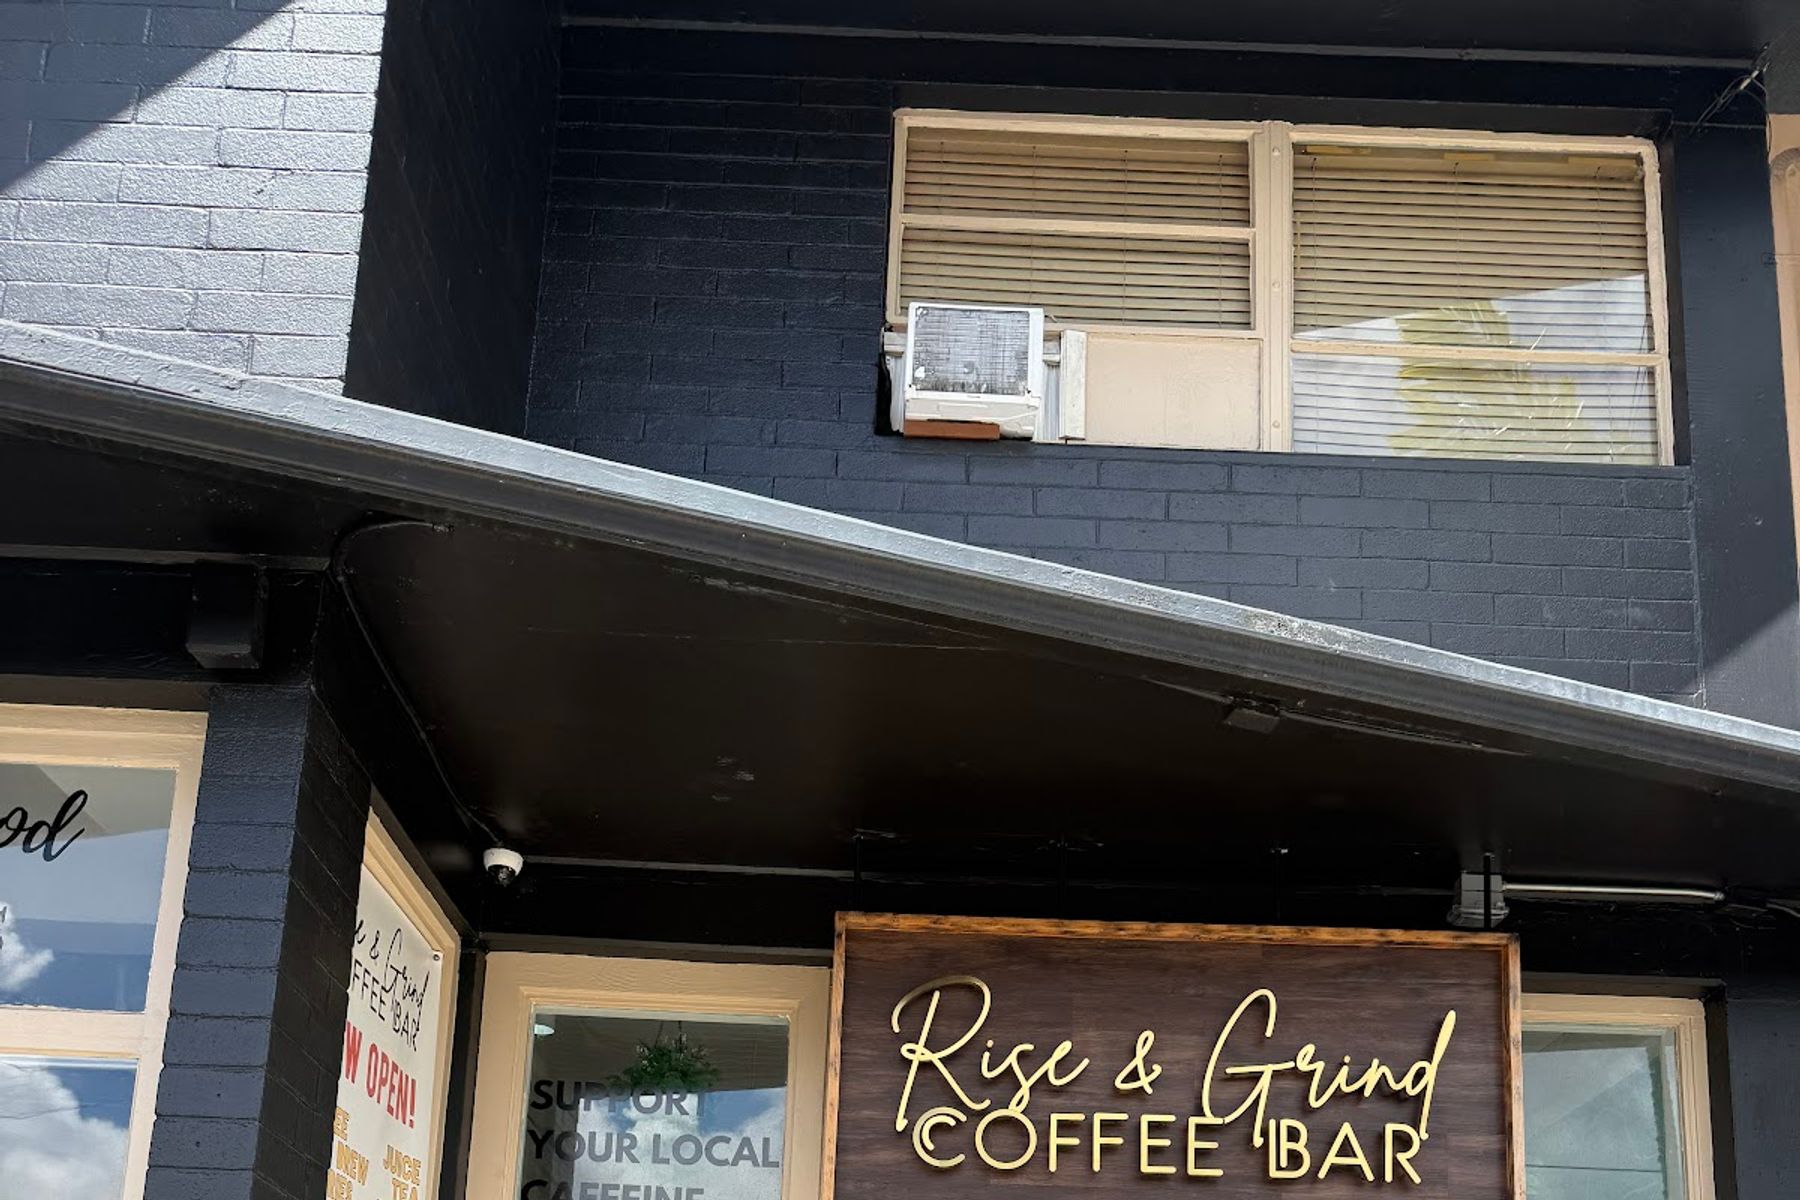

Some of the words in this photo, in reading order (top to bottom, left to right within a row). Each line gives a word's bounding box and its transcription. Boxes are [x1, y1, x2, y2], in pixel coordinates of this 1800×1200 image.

[384, 928, 430, 1031] Grind
[393, 999, 418, 1051] BAR
[366, 1043, 416, 1129] OPEN!
[891, 975, 1090, 1131] Rise
[1114, 1030, 1163, 1094] &
[1202, 988, 1457, 1148] Grind
[530, 1080, 712, 1116] SUPPORT
[383, 1144, 421, 1186] JUICE
[527, 1129, 640, 1164] YOUR
[652, 1133, 779, 1168] LOCAL
[912, 1106, 1224, 1177] COFFEE
[1268, 1118, 1422, 1184] BAR
